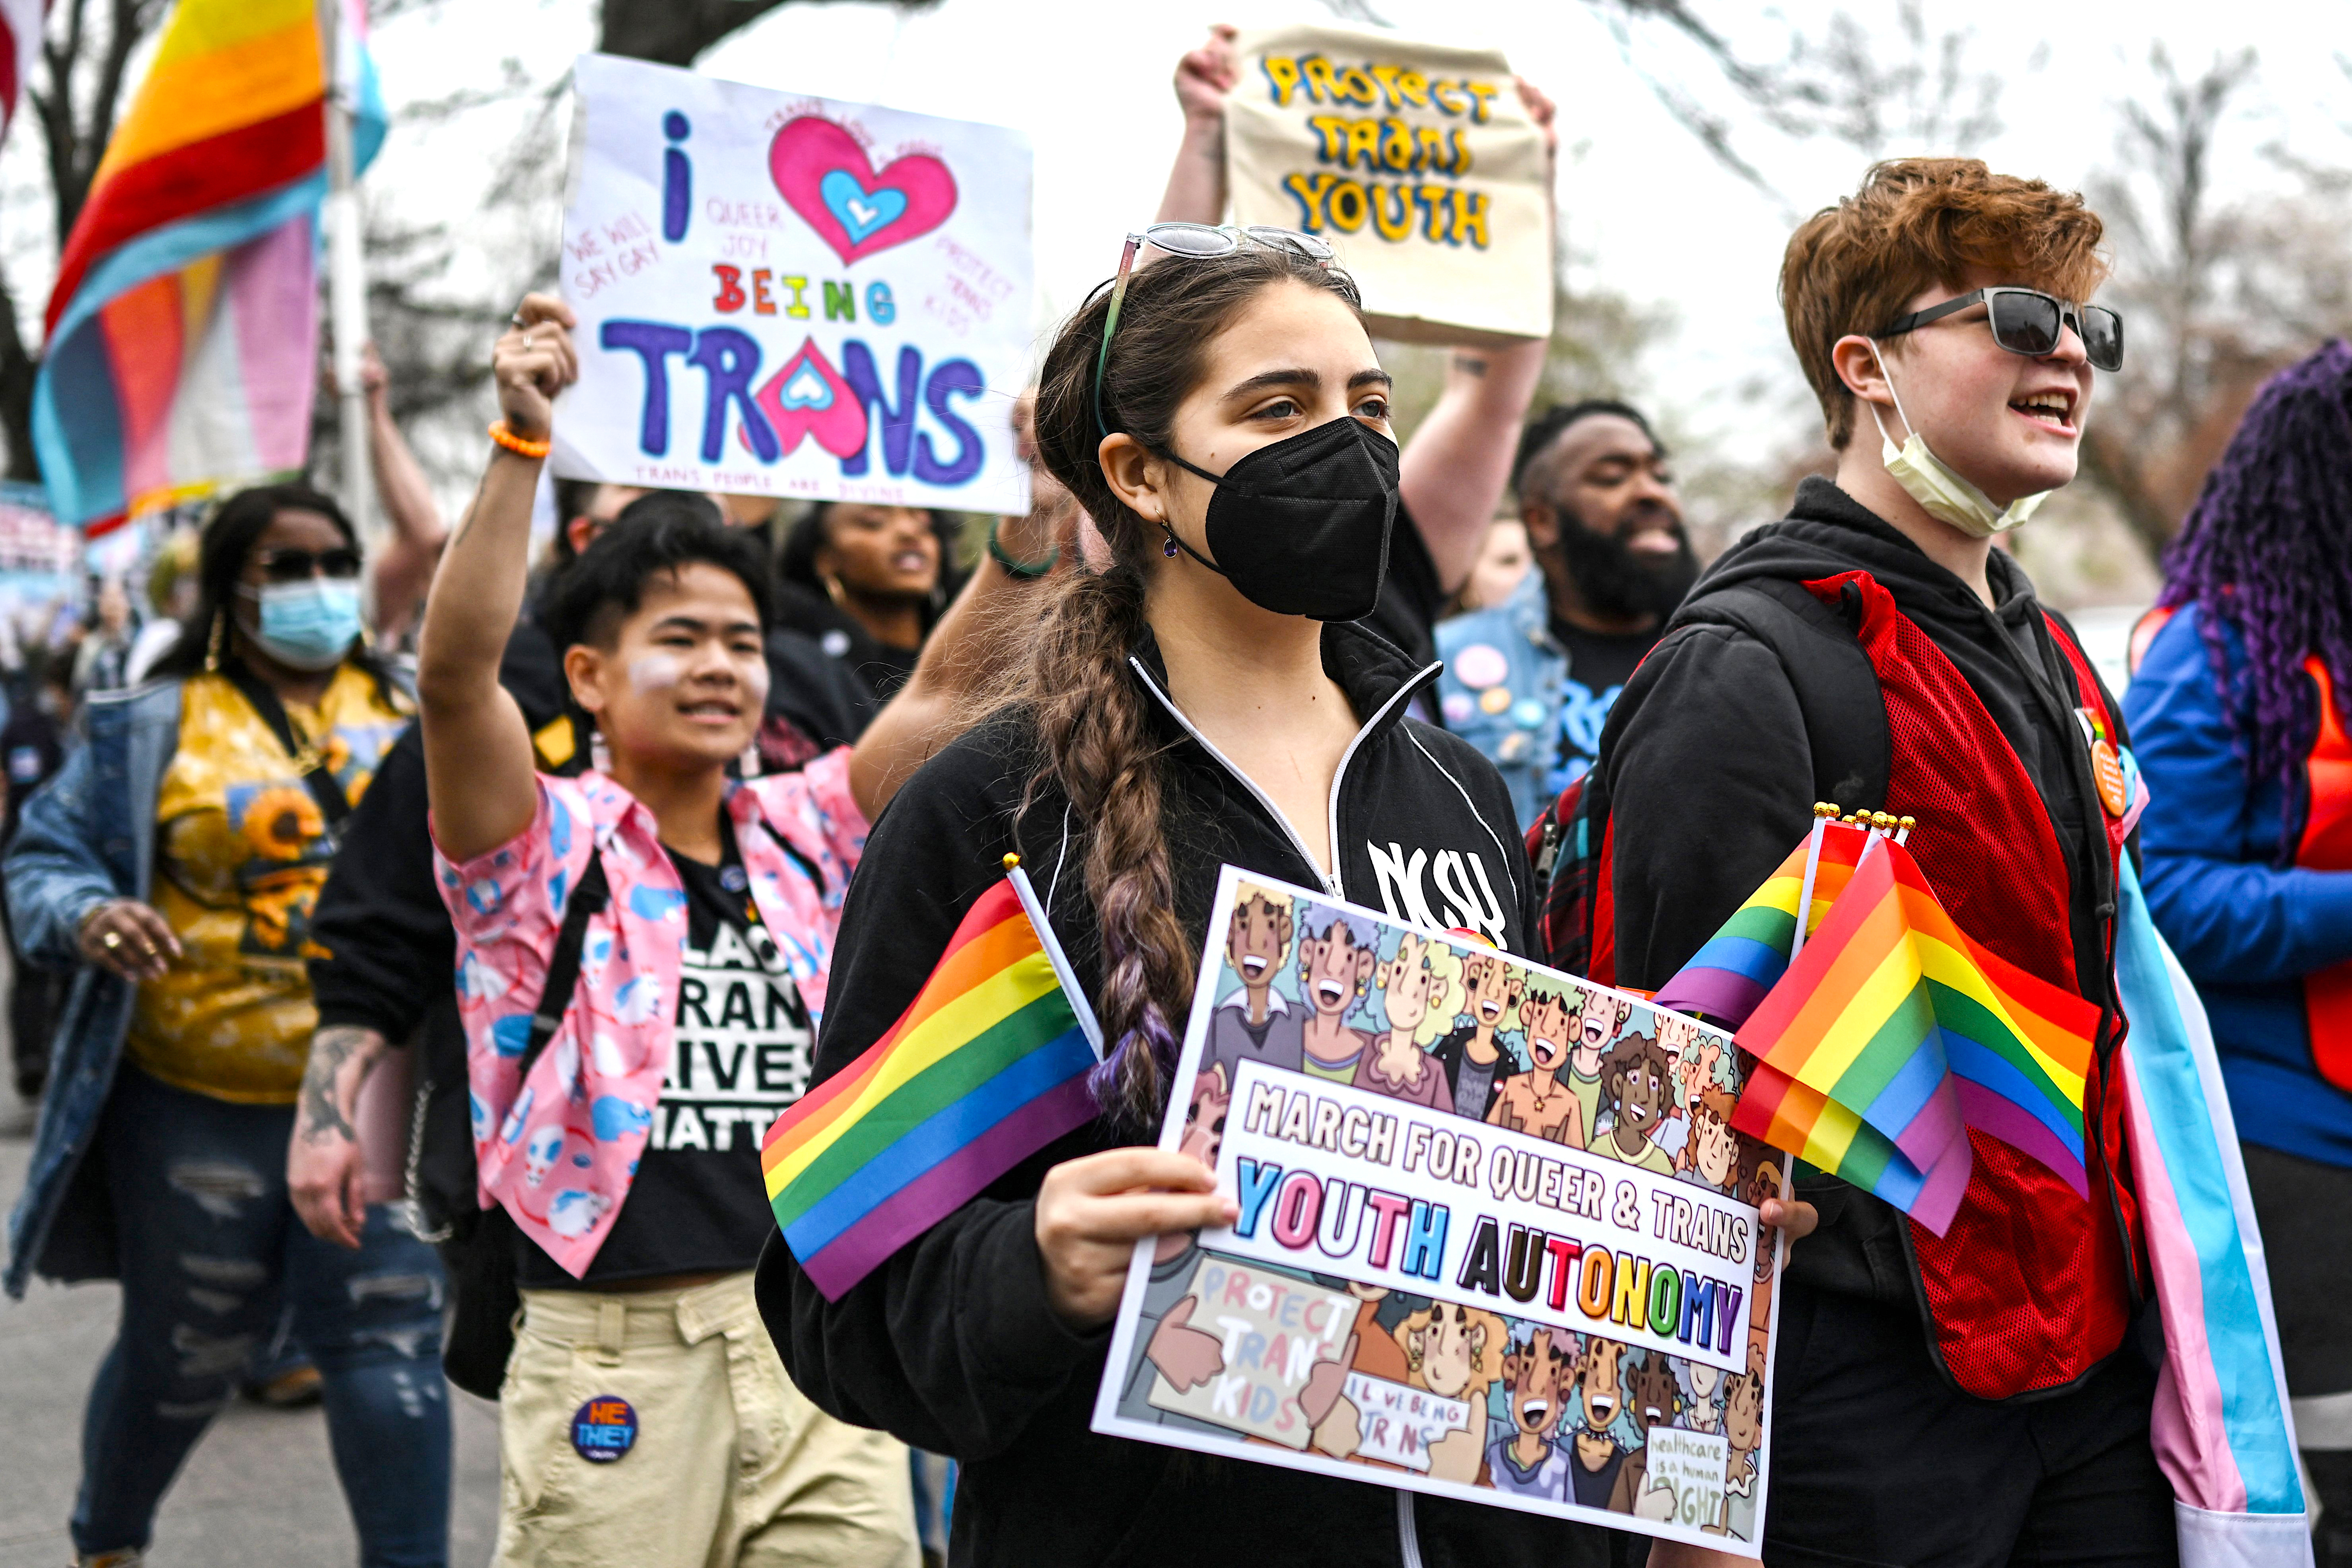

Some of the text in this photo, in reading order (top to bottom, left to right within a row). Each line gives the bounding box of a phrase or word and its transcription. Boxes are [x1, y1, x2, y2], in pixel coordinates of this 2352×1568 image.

[706, 195, 783, 230] QUEER
[1283, 173, 1491, 250] YOUTH
[566, 229, 602, 262] WE
[722, 234, 768, 260] JOY
[575, 238, 659, 299] SAY GAY
[711, 264, 896, 326] BEING
[713, 471, 772, 489] PEOPLE
[675, 977, 811, 1031] RAN
[1244, 1081, 1398, 1166] MARCH
[1403, 1121, 1481, 1189] FOR
[1490, 1144, 1606, 1222] QUEER
[1611, 1179, 1641, 1233] &
[1652, 1189, 1749, 1265] TRANS
[1232, 1156, 1744, 1357] YOUTH AUTONOMY
[1203, 1266, 1352, 1342] PROTECT
[1212, 1375, 1299, 1432] KIDS
[1351, 1378, 1357, 1395] I
[589, 1402, 628, 1425] HE
[577, 1423, 634, 1448] THEY
[1650, 1432, 1722, 1462] healthcare
[1655, 1457, 1719, 1483] is a human
